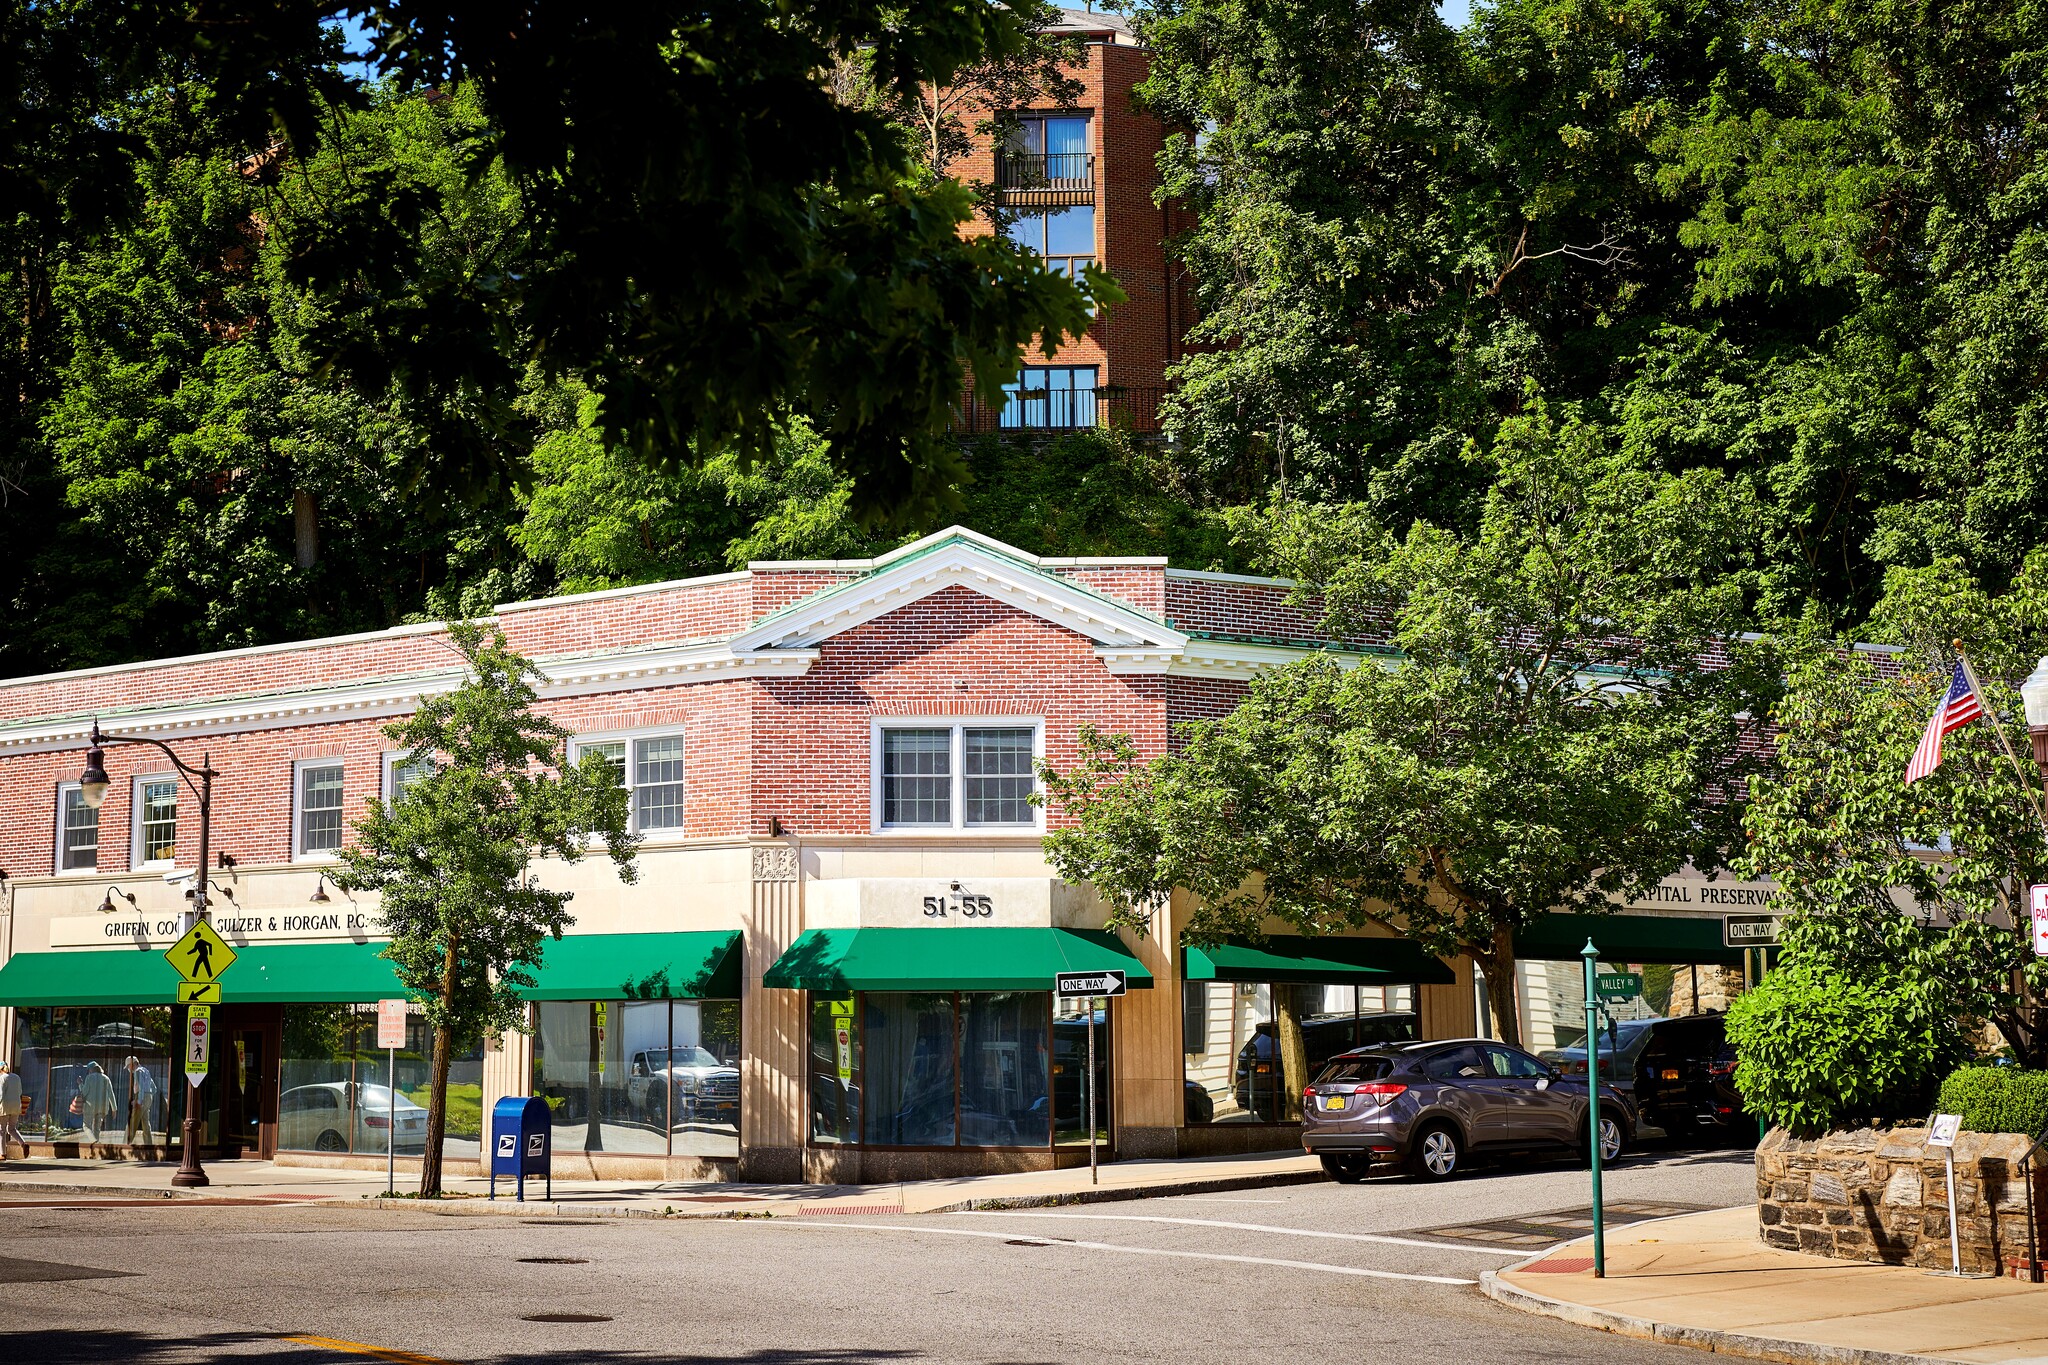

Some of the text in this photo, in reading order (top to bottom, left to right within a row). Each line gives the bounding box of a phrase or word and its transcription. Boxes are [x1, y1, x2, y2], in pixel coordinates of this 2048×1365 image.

[1640, 886, 1692, 902] APITAL
[923, 896, 992, 916] 51-55
[105, 921, 152, 937] GRIFFIN,
[217, 917, 263, 933] SULZER
[268, 916, 277, 931] &
[283, 914, 341, 931] HORGAN,
[347, 913, 368, 929] P.C.
[1732, 923, 1771, 937] ONE WAY
[1063, 979, 1105, 990] ONE WAY
[1601, 978, 1634, 990] VALLEY RD
